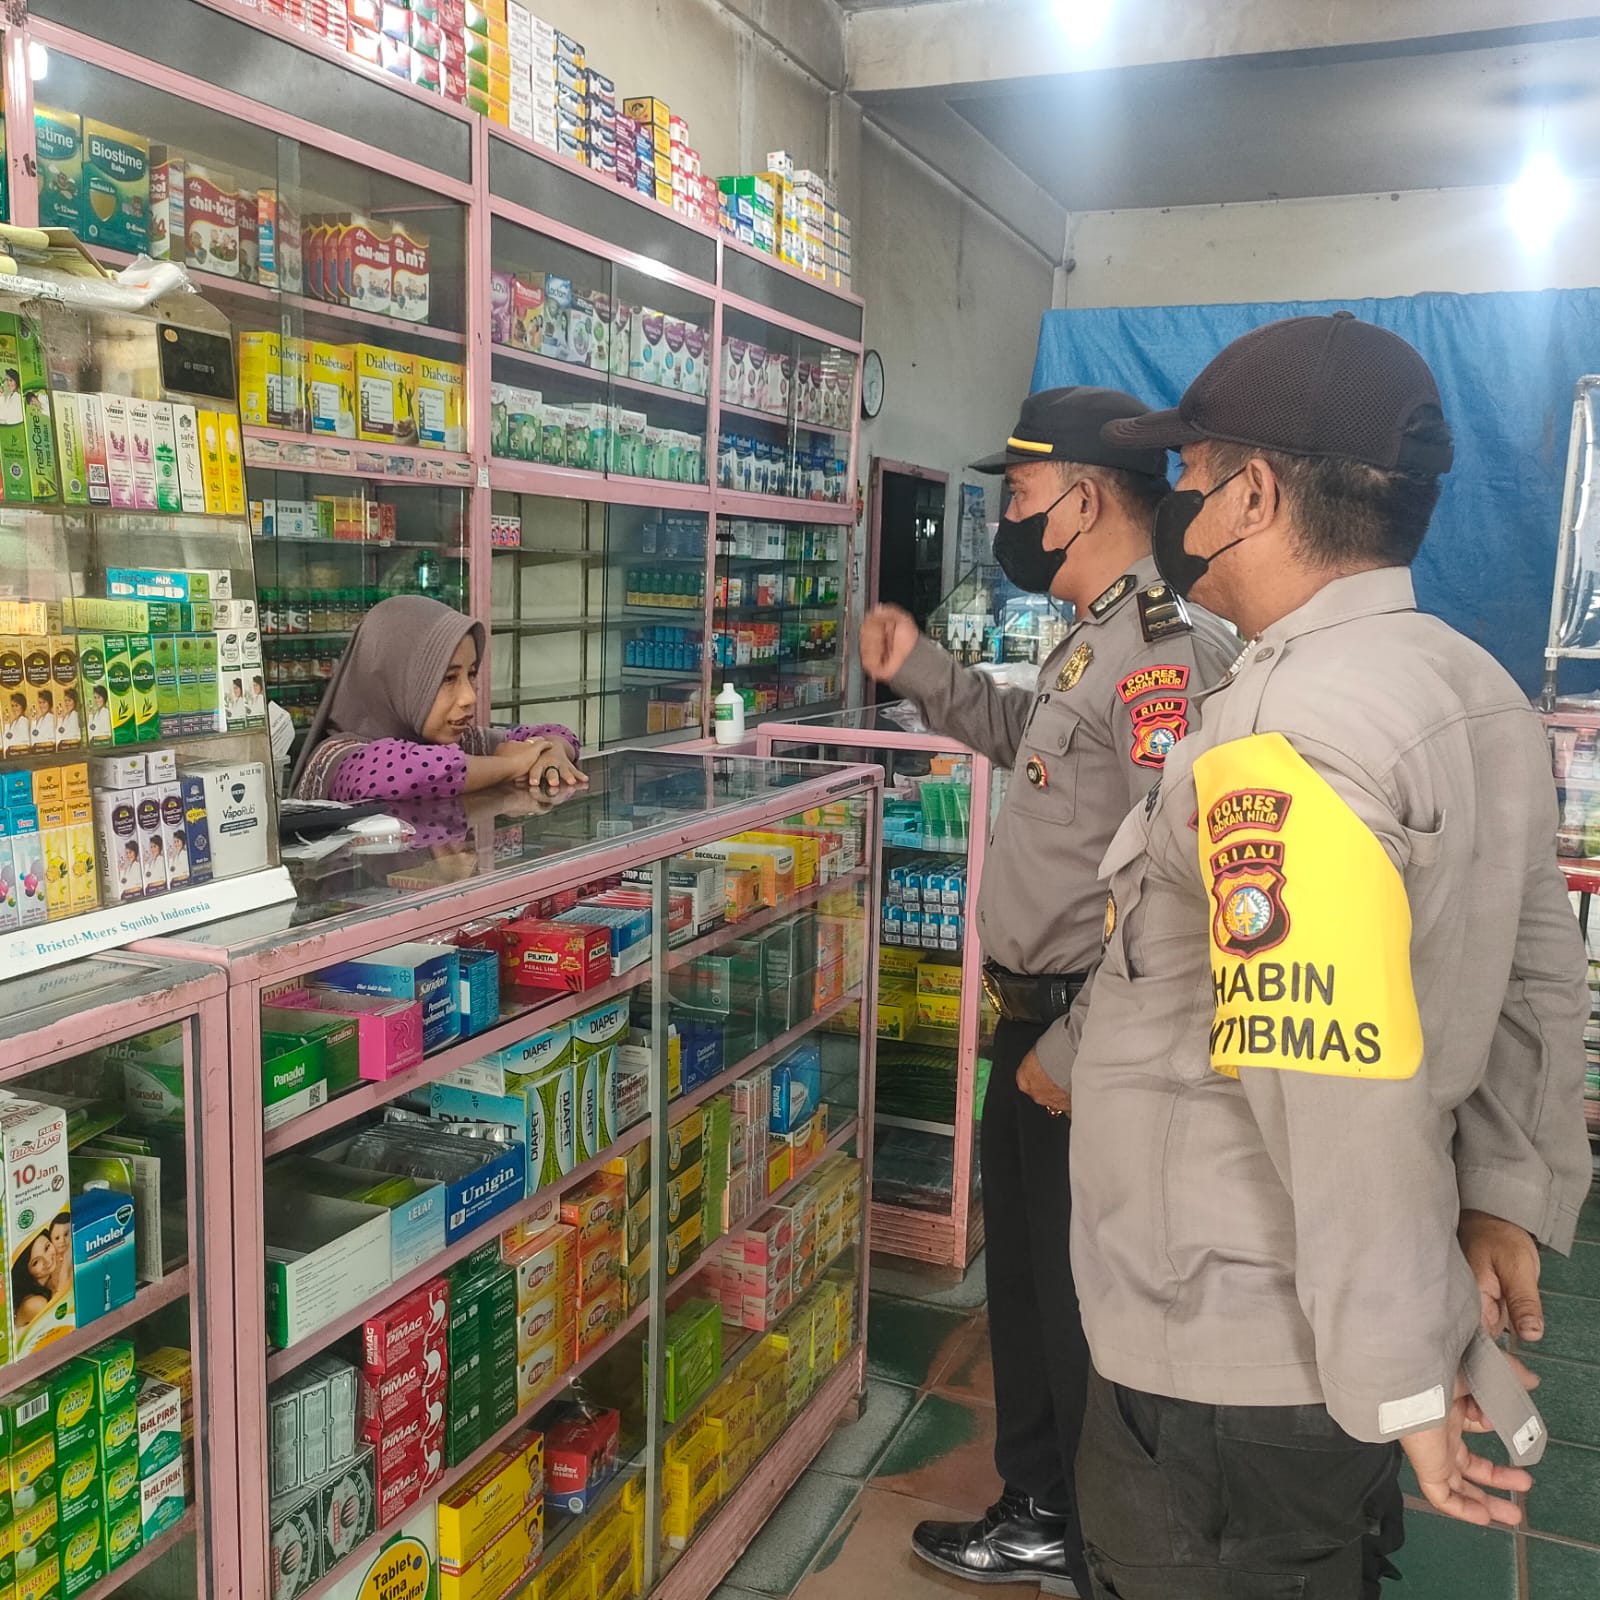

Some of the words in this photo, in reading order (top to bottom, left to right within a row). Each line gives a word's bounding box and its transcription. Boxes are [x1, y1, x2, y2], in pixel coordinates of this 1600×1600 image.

[37, 126, 73, 148] stime
[91, 140, 143, 170] Biostime
[111, 163, 125, 174] Baby
[314, 353, 352, 371] Diabetasol
[366, 353, 414, 376] Diabetasol
[422, 365, 464, 386] Diabetasol
[32, 415, 46, 476] FreshCare
[64, 422, 74, 471] PLOSSA
[1125, 679, 1155, 697] ROKAN
[1126, 669, 1177, 689] POLRES
[1140, 702, 1174, 716] RIAU
[222, 806, 255, 820] VapoRub
[1214, 794, 1276, 821] POLRES
[1213, 811, 1243, 835] ROKAN
[1247, 810, 1279, 824] HILIR
[694, 852, 726, 861] DECOLGEN
[1217, 845, 1275, 868] RIAU
[622, 870, 638, 880] STOP
[639, 872, 653, 881] COL
[36, 925, 117, 955] Bristol-Myers
[120, 912, 159, 932] Squibb
[161, 901, 211, 922] Indonesia
[527, 953, 554, 962] PILKITA
[420, 975, 447, 996] Saridon
[1213, 961, 1335, 1008] HABIN
[589, 1011, 619, 1034] DIAPET
[522, 1038, 553, 1061] DIAPET
[273, 1063, 305, 1088] Panadol
[773, 1085, 782, 1118] Panadol
[563, 1090, 572, 1149] DIAPET
[531, 1111, 539, 1163] DIAPET
[13, 1164, 36, 1189] 10
[37, 1165, 58, 1180] Jam
[460, 1167, 515, 1205] Unigin
[408, 1198, 433, 1222] LELAP
[85, 1226, 125, 1253] Inhaler
[386, 1316, 423, 1348] PIMAG
[367, 1327, 375, 1365] PIMAG
[380, 1366, 416, 1400] PIMAG
[140, 1403, 178, 1434] BALPIRIK
[382, 1420, 419, 1452] PIMAG
[143, 1469, 181, 1501] BALPIRIK
[382, 1468, 419, 1504] PIMAG
[373, 1552, 411, 1590] Tablet
[380, 1578, 407, 1600] Kina
